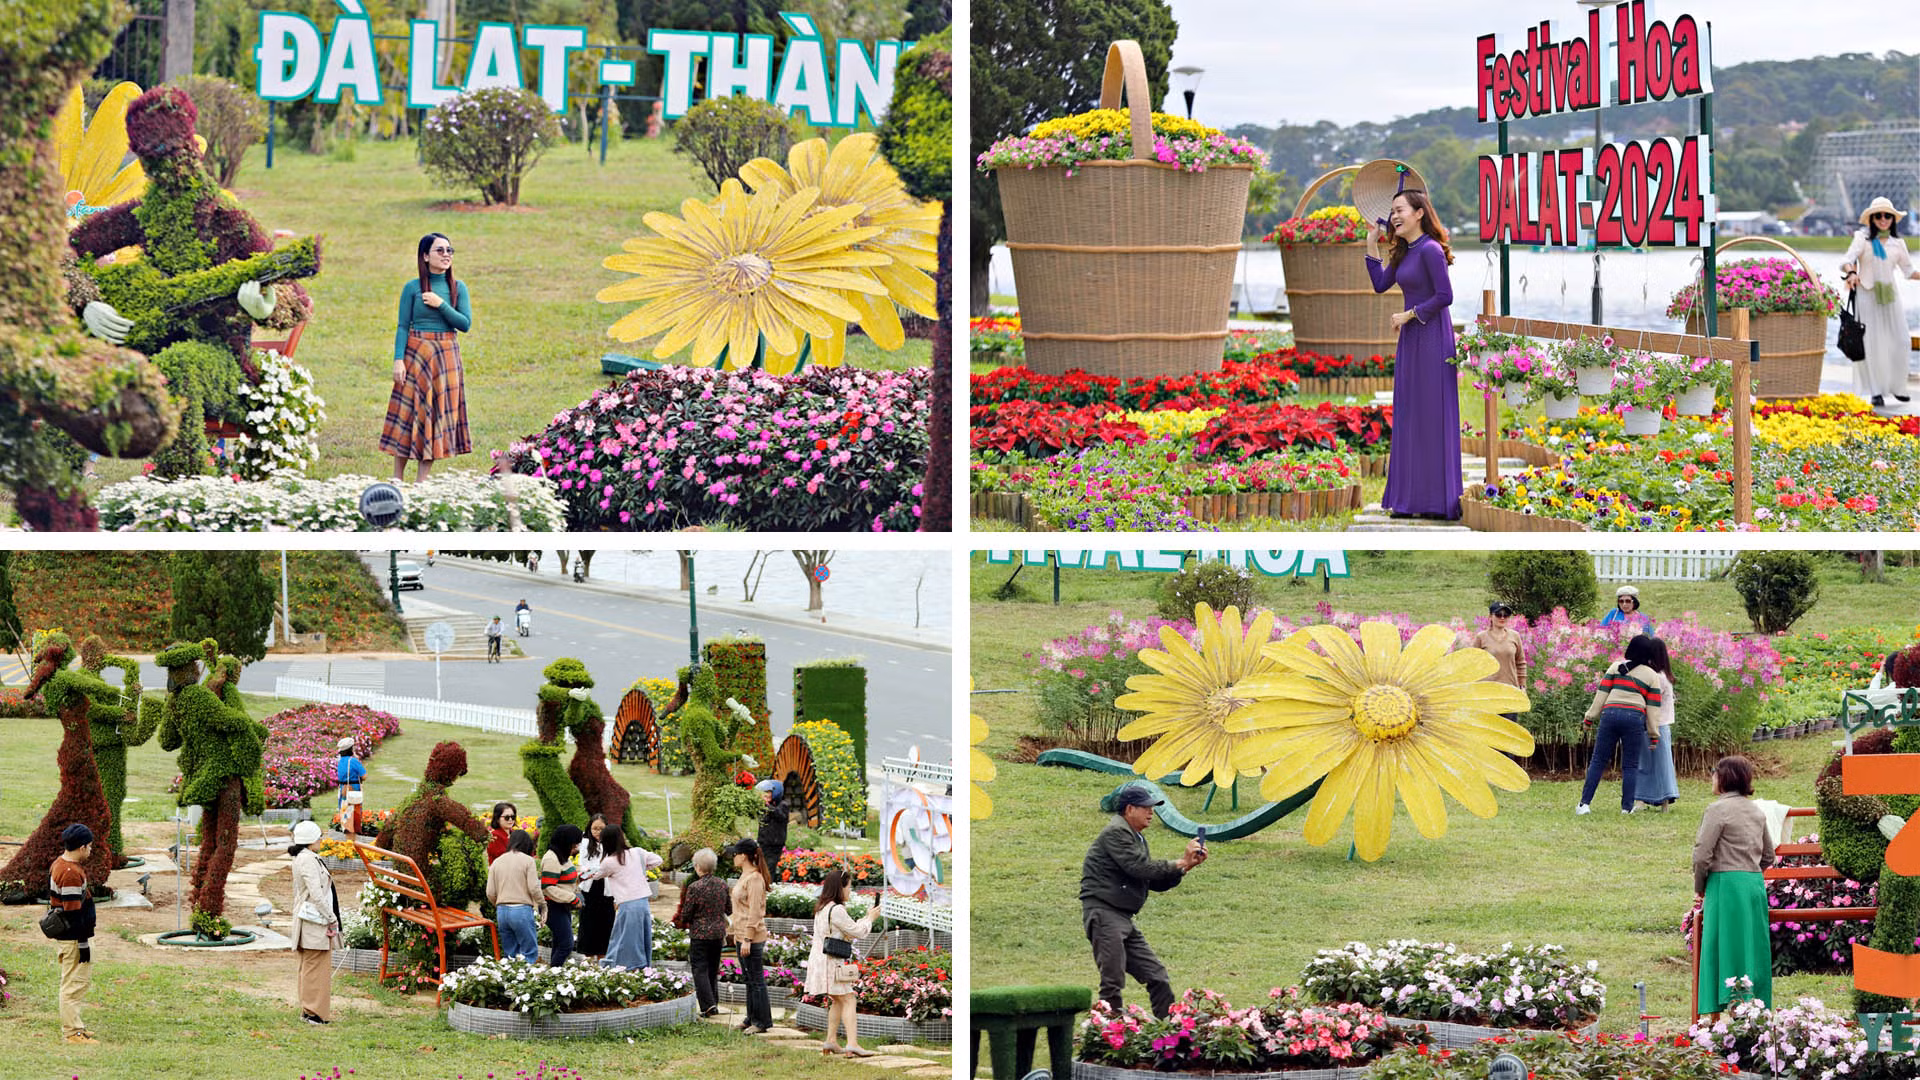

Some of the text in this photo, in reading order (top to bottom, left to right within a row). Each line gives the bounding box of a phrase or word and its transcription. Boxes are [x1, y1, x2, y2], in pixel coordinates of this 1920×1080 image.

[253, 0, 384, 105] ĐÀ
[648, 11, 917, 128] THÀN
[1477, 0, 1702, 122] Festival Hoa
[1479, 136, 1705, 247] DALAT-2024
[1842, 688, 1920, 734] Dal
[1856, 1012, 1920, 1051] YE
